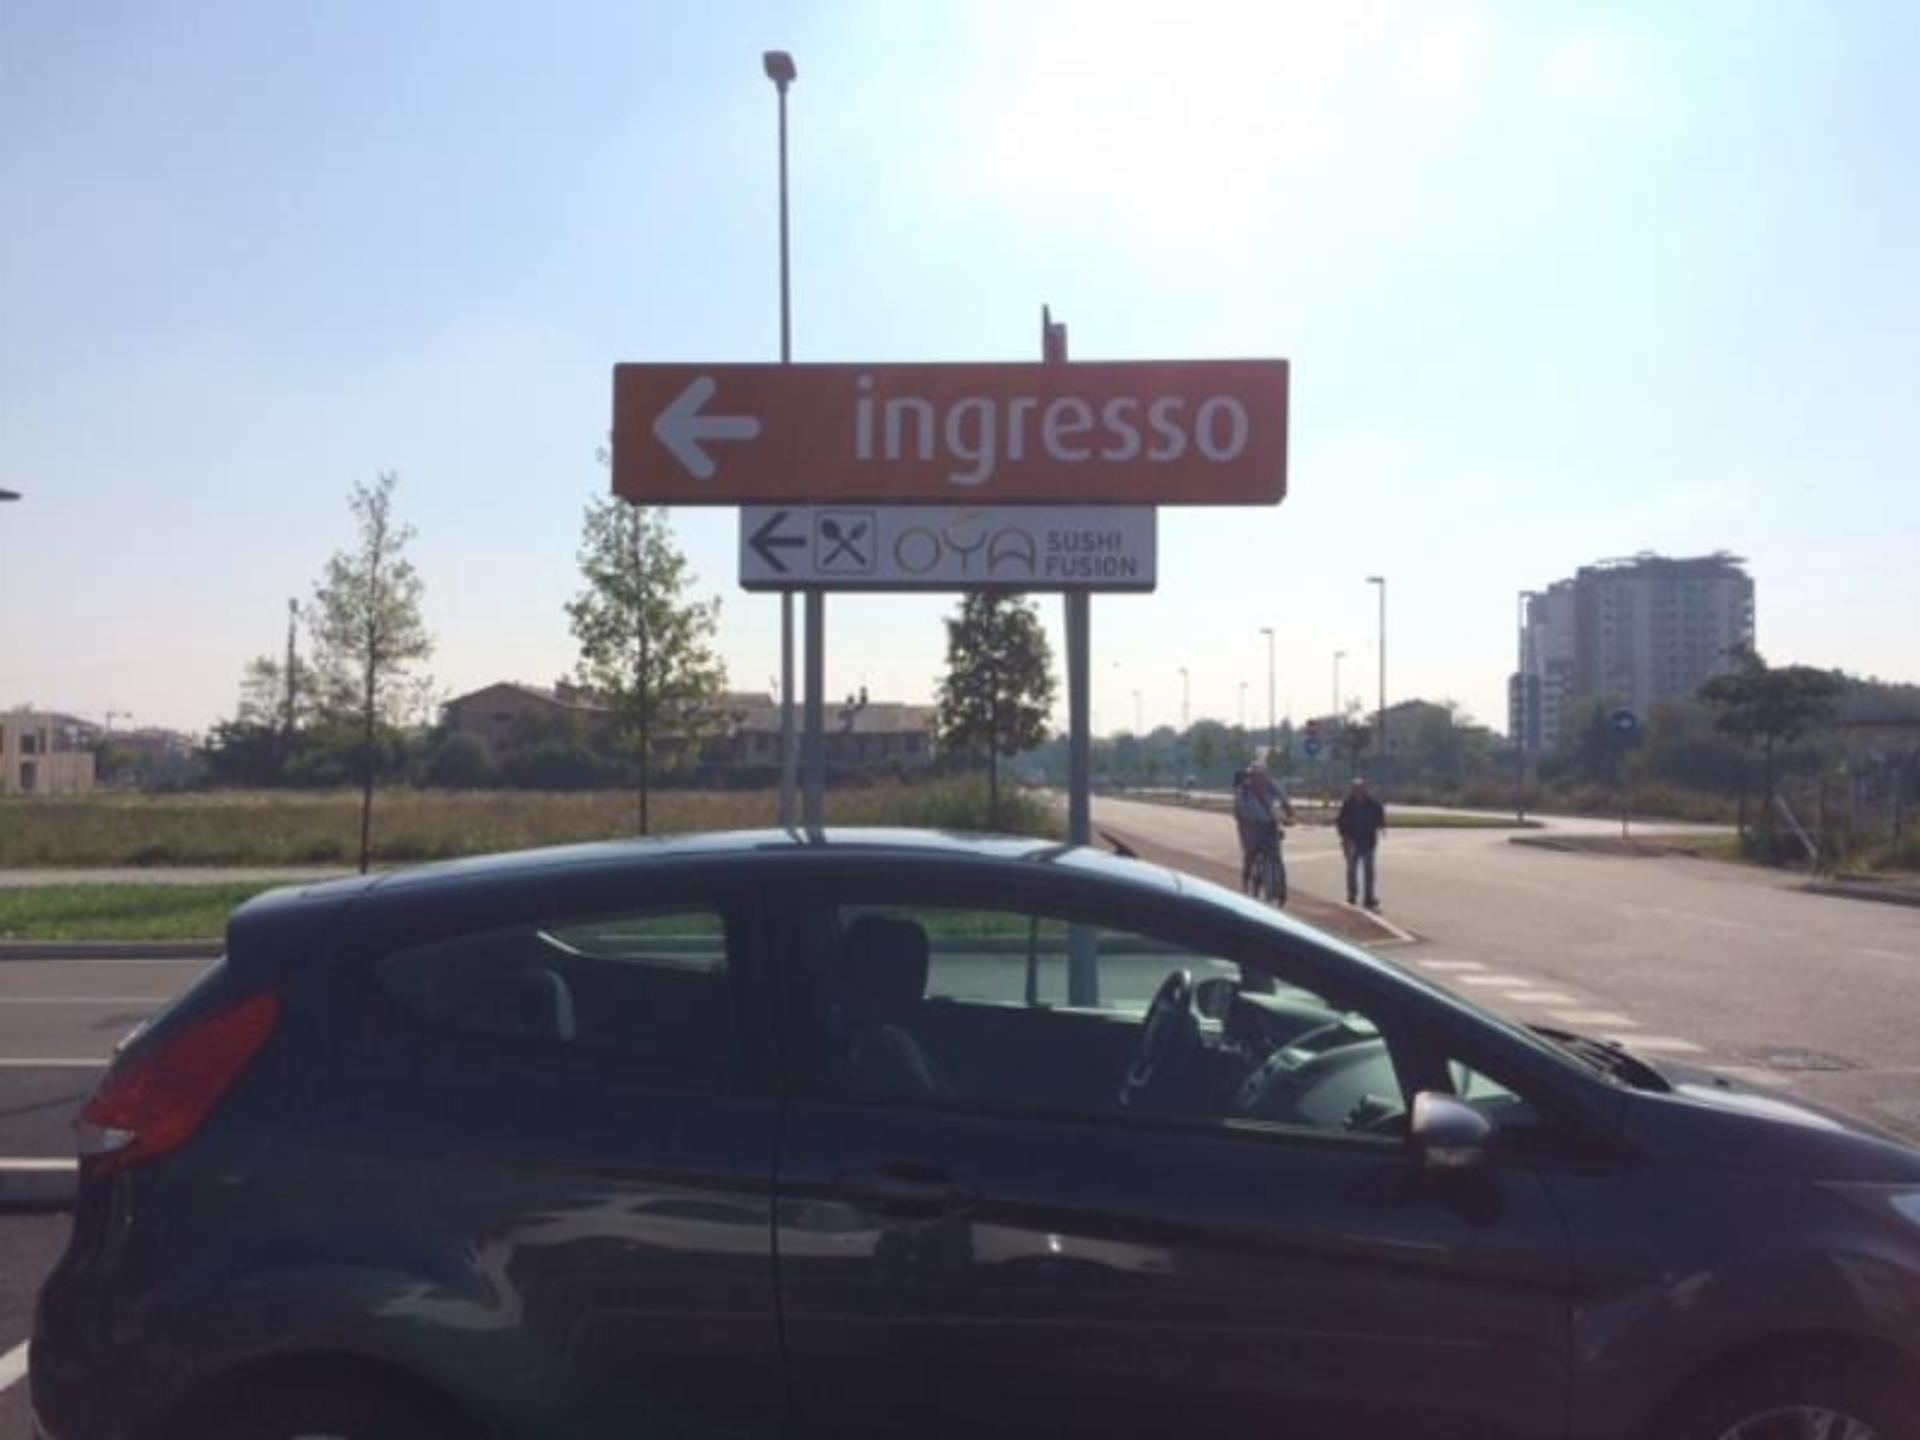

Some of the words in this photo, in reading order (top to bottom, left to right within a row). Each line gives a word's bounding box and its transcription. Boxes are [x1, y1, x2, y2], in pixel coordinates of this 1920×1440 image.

[855, 375, 1250, 485] ingresso
[893, 525, 1037, 576] OYA
[1045, 530, 1122, 554] SUSHI
[1045, 555, 1138, 577] FUSION
